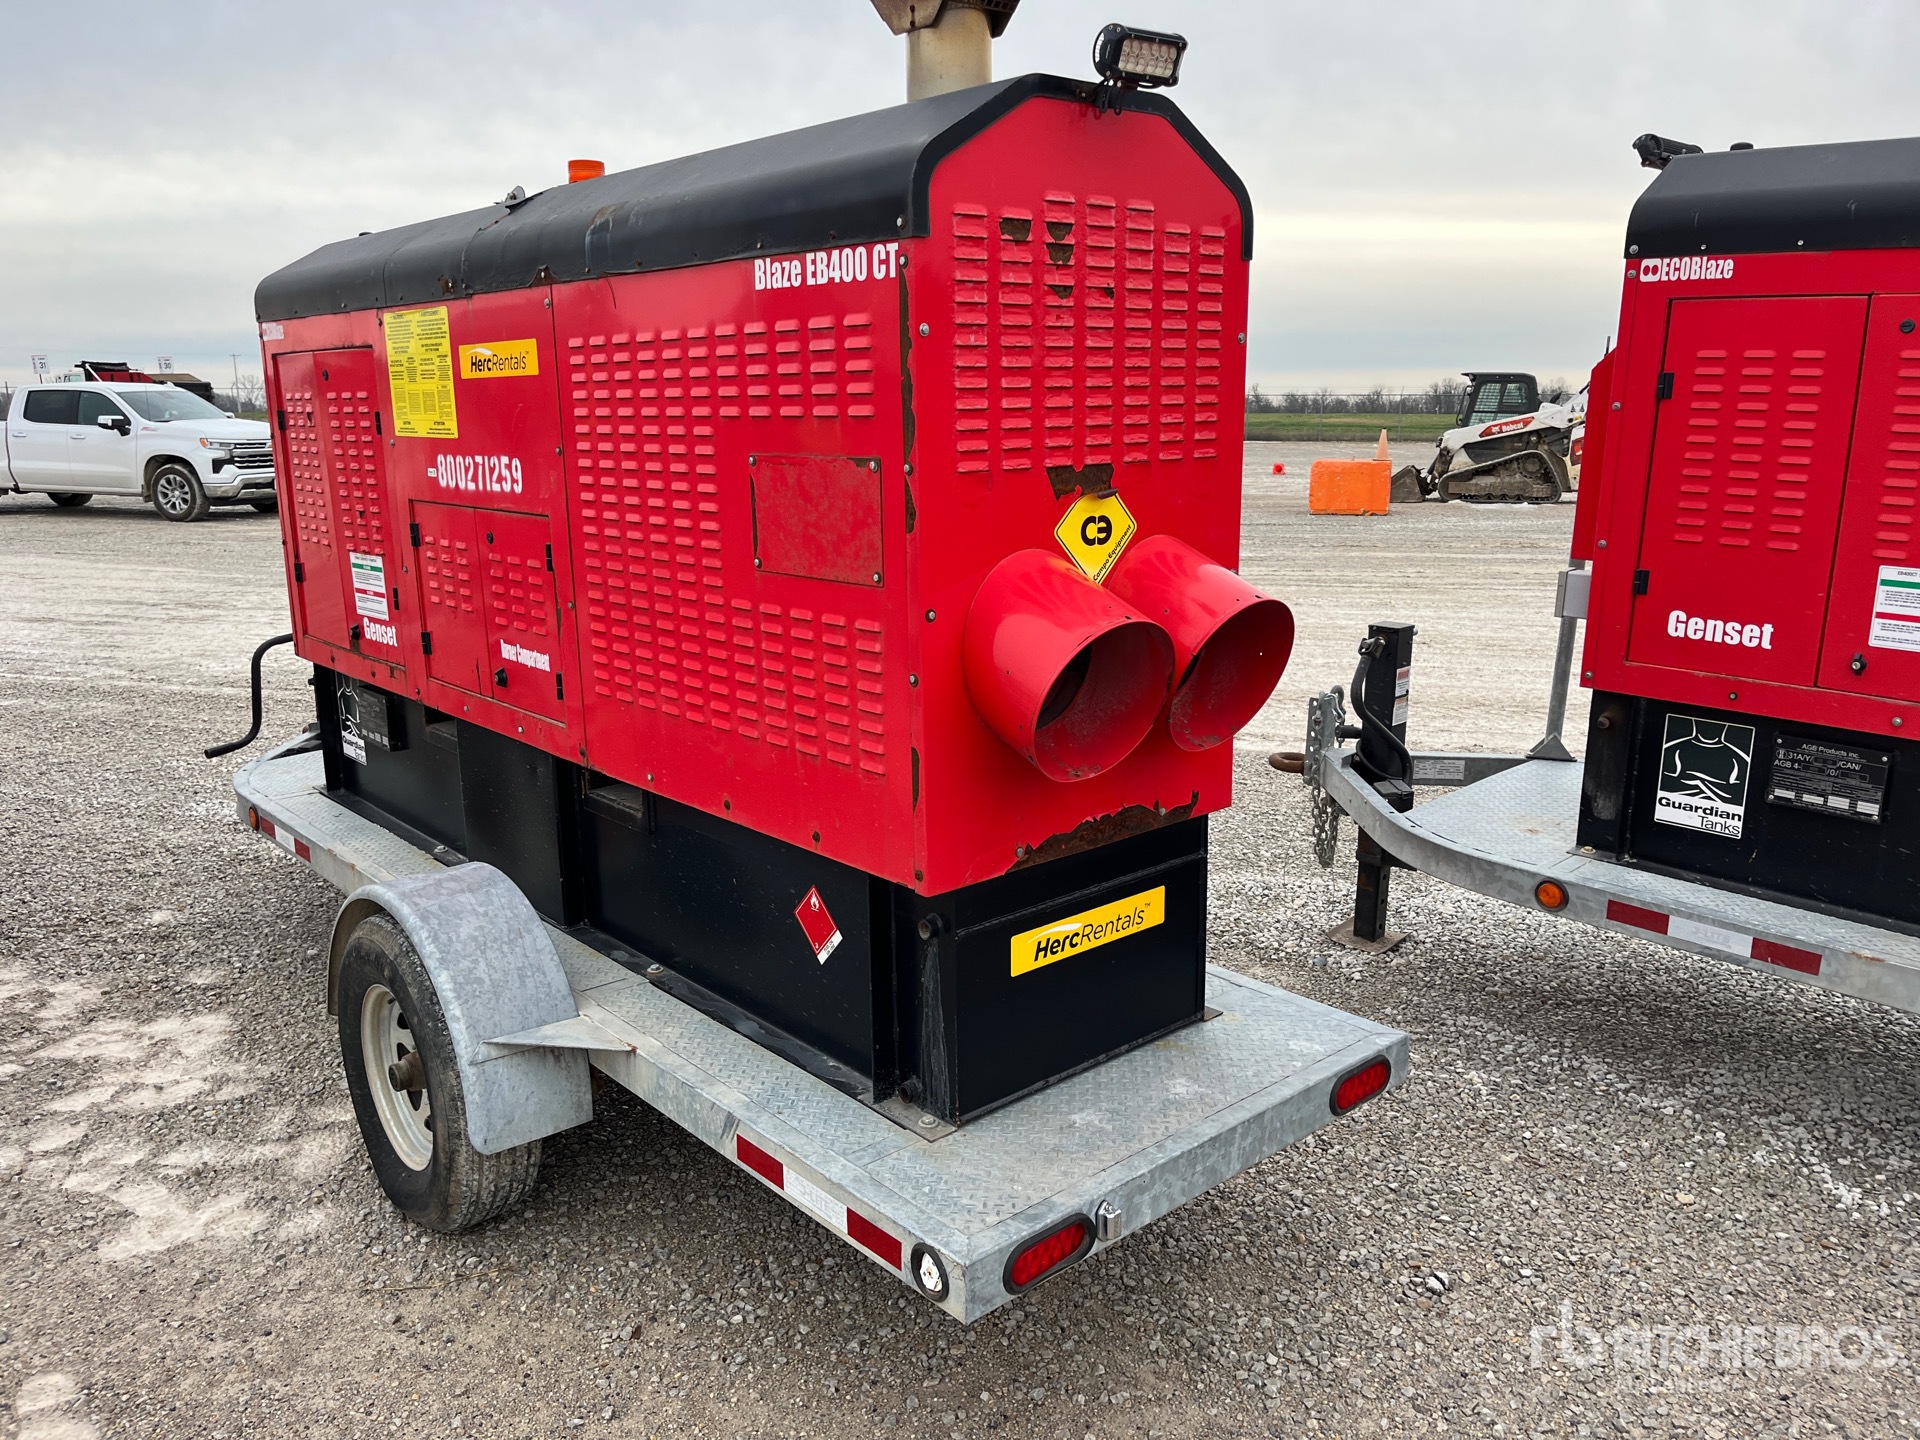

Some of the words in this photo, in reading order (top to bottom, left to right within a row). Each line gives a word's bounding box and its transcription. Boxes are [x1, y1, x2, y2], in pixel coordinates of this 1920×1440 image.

[754, 258, 802, 291] Blaze
[806, 245, 868, 286] EB400
[872, 242, 899, 280] CT
[1661, 256, 1734, 282] ECOBlaze
[38, 361, 47, 370] 31
[470, 351, 527, 373] HercRentals
[1502, 421, 1524, 433] Bobcat
[437, 453, 523, 494] 800271259
[1092, 559, 1110, 581] Campo
[1107, 524, 1132, 559] Equipment
[363, 616, 398, 647] Genset
[1667, 610, 1774, 650] Genset
[342, 735, 366, 753] Guardian
[1801, 743, 1817, 752] AGB
[1818, 746, 1847, 757] Products
[1774, 759, 1792, 768] AGB
[1657, 796, 1743, 822] Guardian
[1697, 815, 1741, 836] Tanks
[1033, 907, 1145, 962] HercRentals
